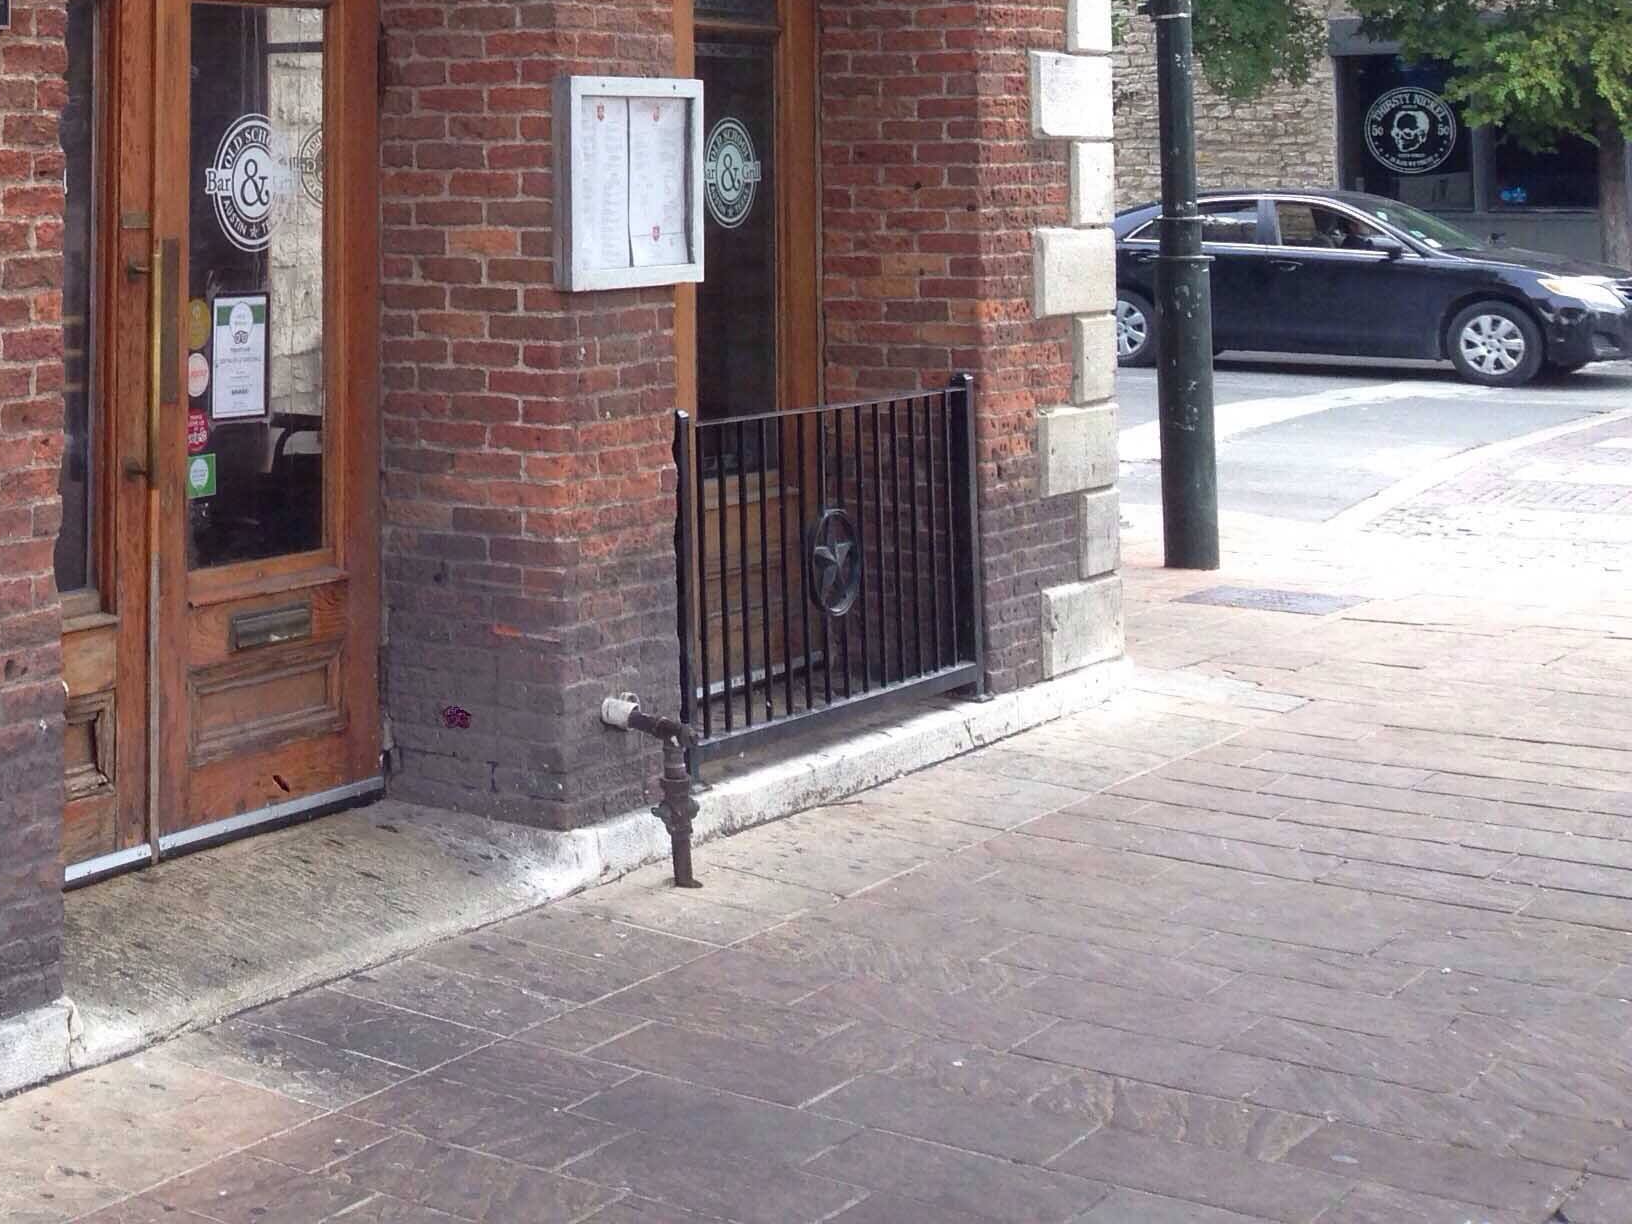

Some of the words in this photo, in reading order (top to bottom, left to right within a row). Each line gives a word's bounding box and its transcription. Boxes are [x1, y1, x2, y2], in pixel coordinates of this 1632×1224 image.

[1374, 93, 1410, 121] THIRSTY
[1413, 94, 1447, 122] NICKEL
[224, 135, 244, 169] OLD
[207, 170, 231, 192] Bar
[240, 158, 270, 207] &
[721, 153, 742, 192] &
[223, 200, 248, 236] AUSTIN
